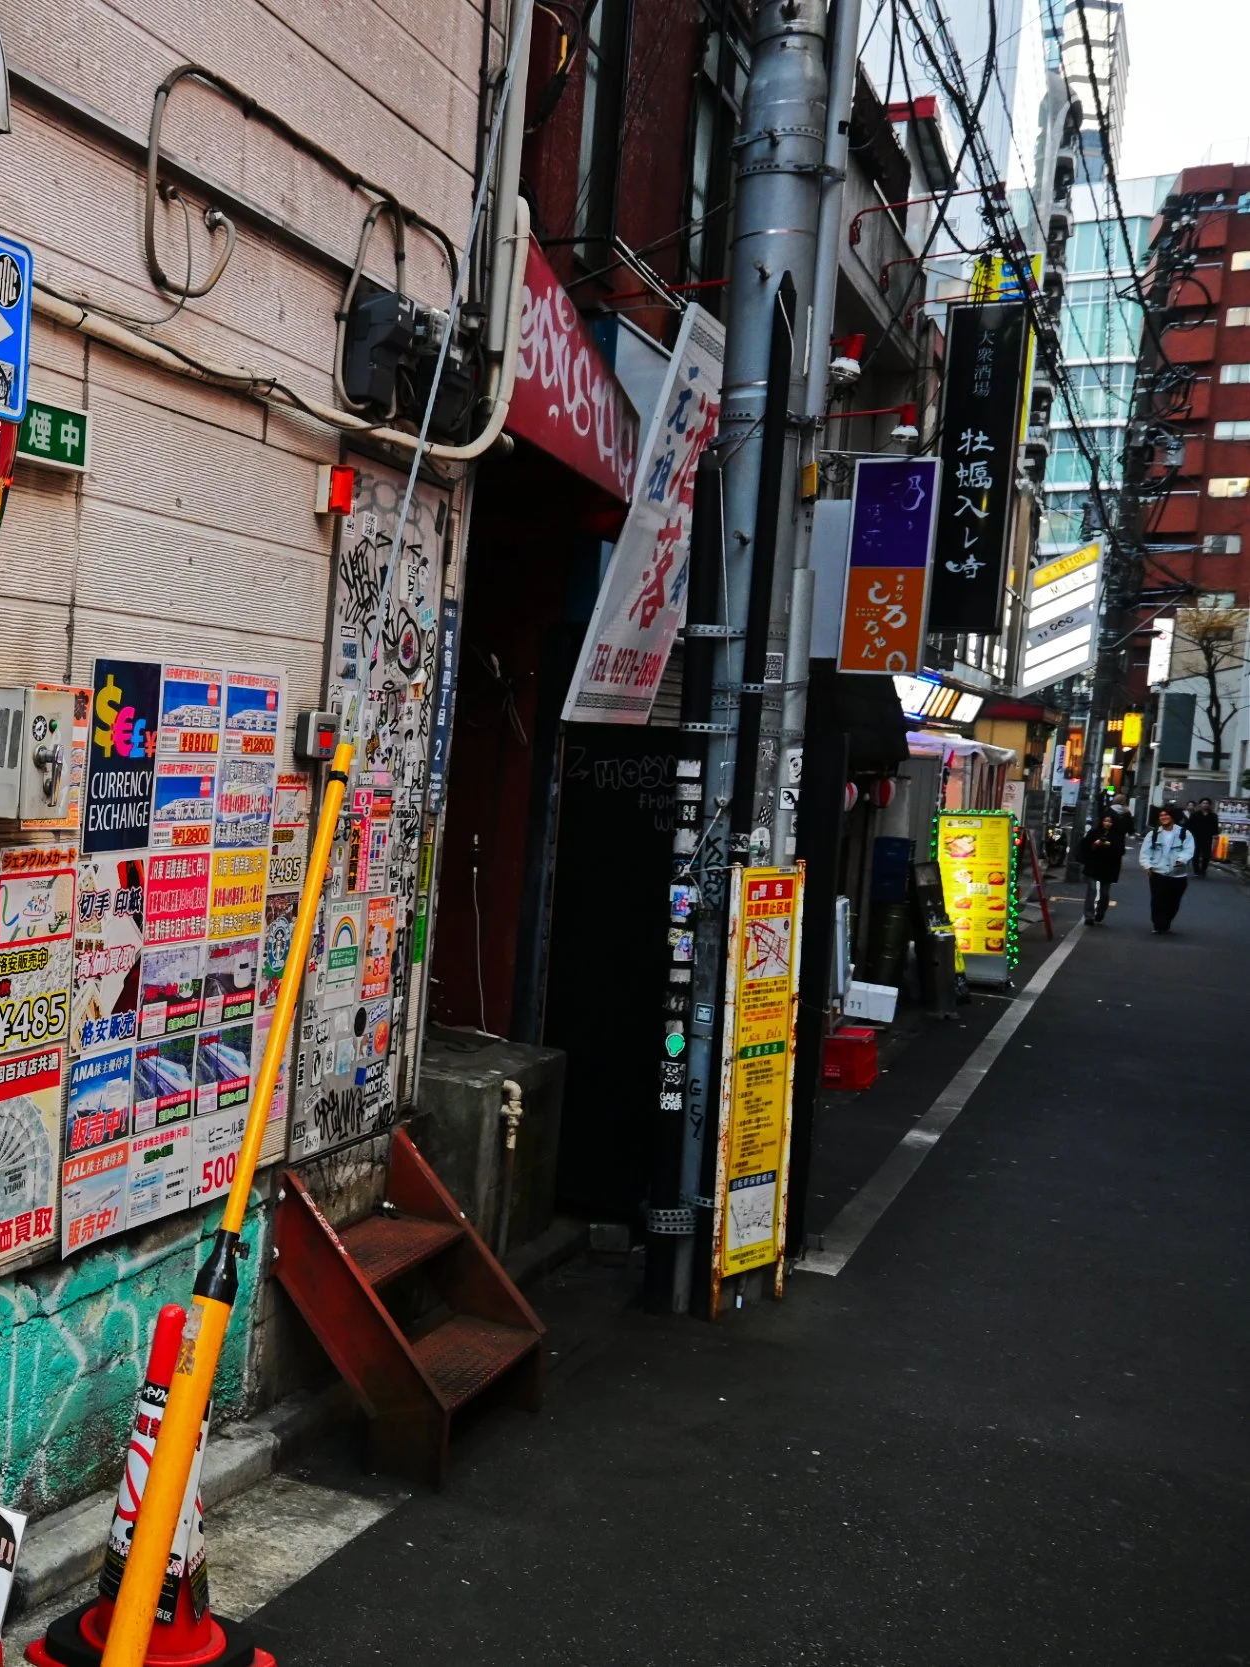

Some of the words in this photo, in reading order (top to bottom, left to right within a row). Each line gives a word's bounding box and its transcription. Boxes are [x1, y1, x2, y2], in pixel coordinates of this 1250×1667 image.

[973, 327, 996, 399] 大衆酒場
[28, 408, 80, 458] 煙中
[1054, 552, 1087, 574] TATTOO
[589, 643, 613, 682] TEL
[433, 738, 443, 761] 2
[91, 770, 153, 800] CURRENCY
[88, 801, 150, 832] EXCHANGE
[270, 857, 301, 884] ¥485
[79, 890, 111, 922] 切手
[114, 886, 143, 916] 印紙
[76, 943, 136, 980] 高価買取
[80, 1010, 137, 1047] 格安販売
[72, 1054, 130, 1085] ANA株主優待券
[70, 1106, 127, 1152] 販売中!
[208, 1118, 245, 1144] ビニール傘
[65, 1149, 124, 1182] JAL株主優待券
[201, 1151, 236, 1194] 500
[67, 1206, 119, 1250] 販売中!
